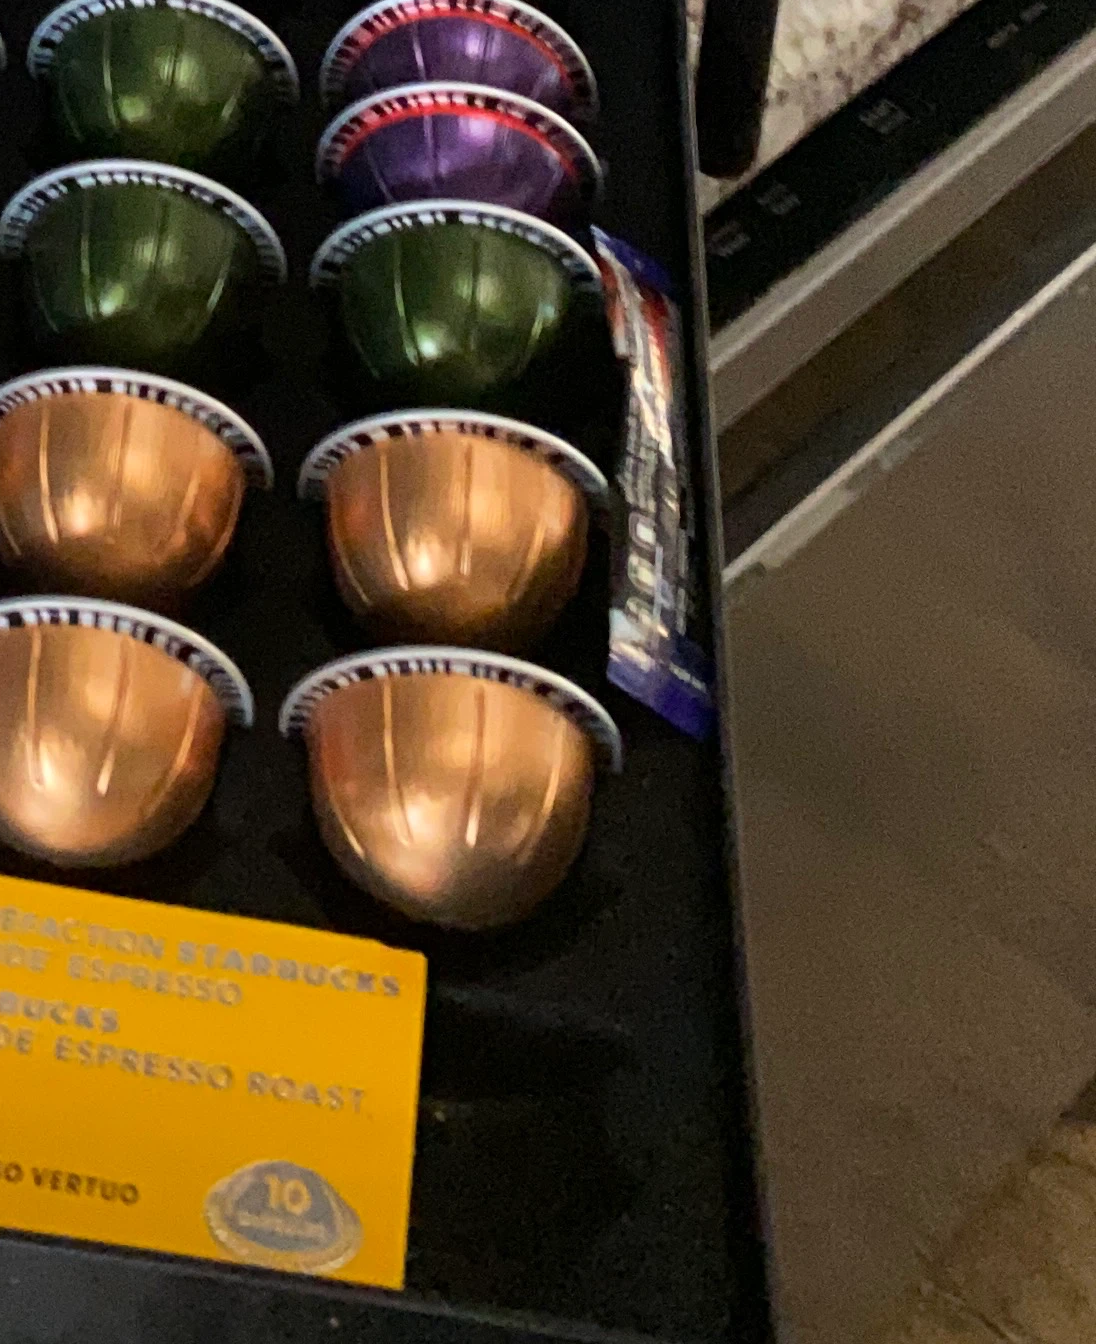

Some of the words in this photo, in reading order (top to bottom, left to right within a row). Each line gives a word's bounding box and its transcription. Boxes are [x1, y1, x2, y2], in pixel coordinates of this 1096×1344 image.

[67, 954, 243, 1006] ESPRESSO
[178, 940, 401, 997] STARBUCKS
[55, 1035, 234, 1090] ESPRESSO
[247, 1071, 365, 1112] ROAST
[31, 1167, 140, 1206] VERTUO
[263, 1174, 313, 1216] 10
